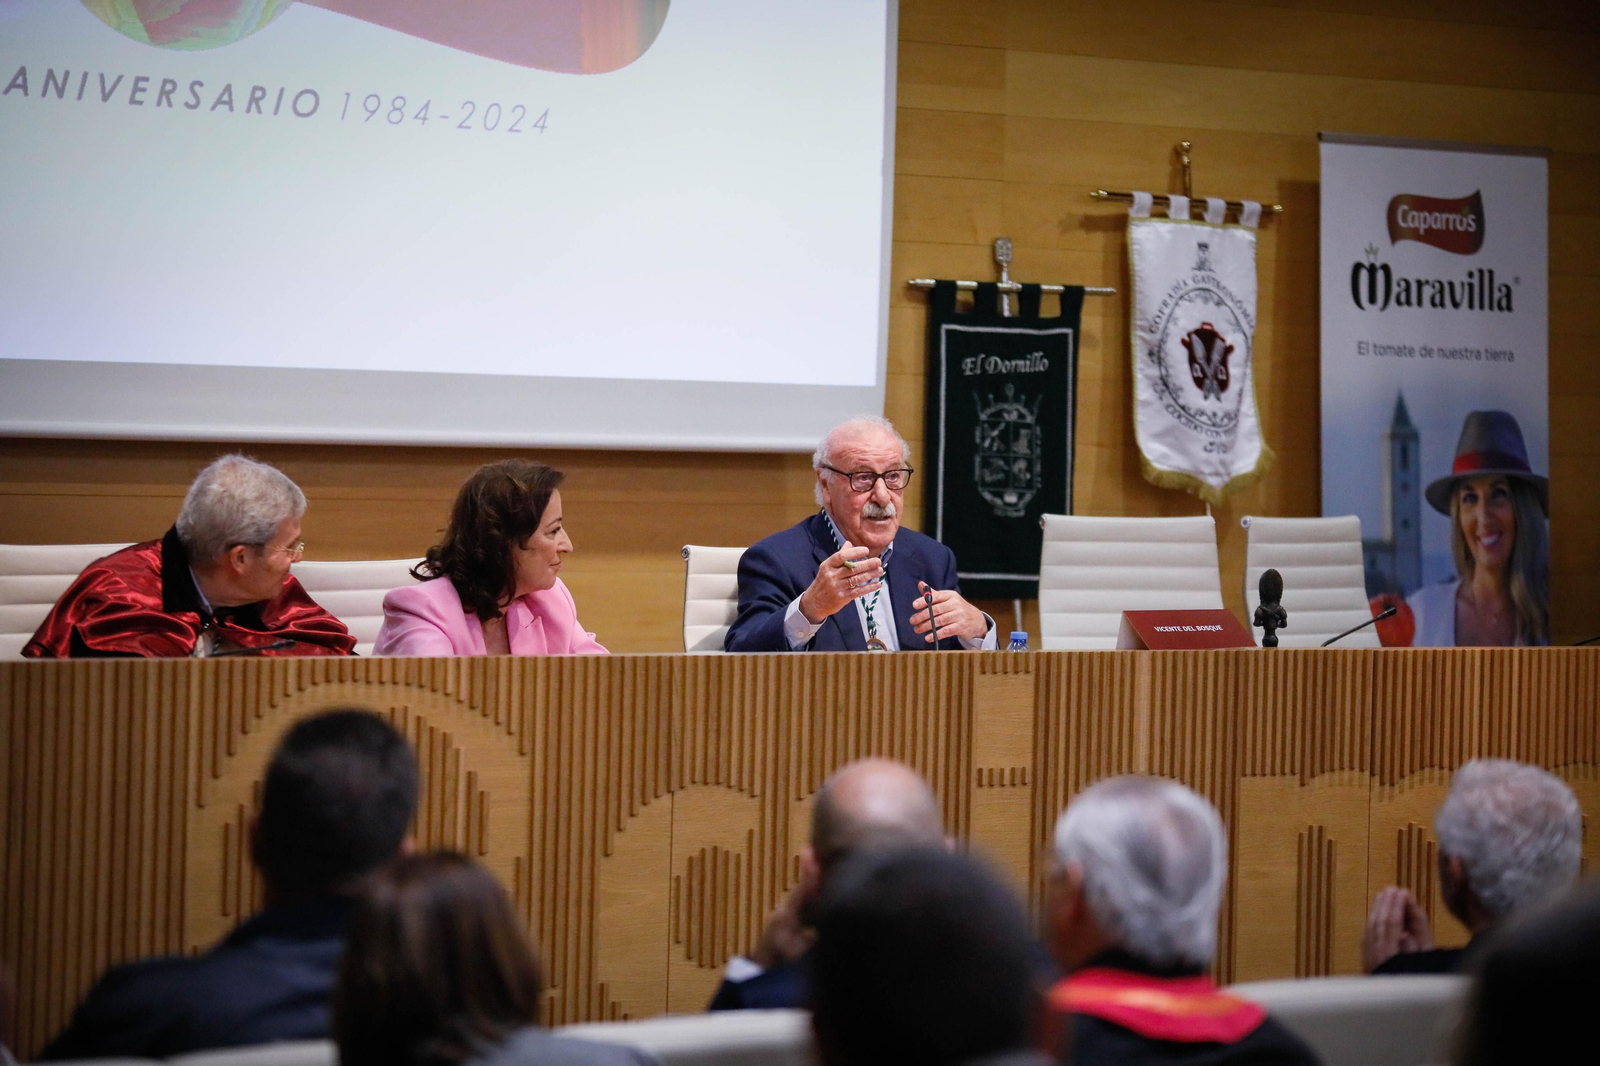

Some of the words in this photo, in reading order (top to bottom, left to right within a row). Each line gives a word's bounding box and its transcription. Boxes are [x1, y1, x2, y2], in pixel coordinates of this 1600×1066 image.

[2, 65, 321, 119] ANIVERSARIO
[339, 91, 550, 136] 1984-2024
[1351, 260, 1514, 313] Maravilla
[962, 353, 985, 376] El
[985, 350, 1049, 374] Dornillo
[1357, 340, 1370, 356] El
[1419, 344, 1435, 359] de
[1437, 347, 1482, 361] nuestra
[1485, 347, 1515, 363] tierra
[1195, 624, 1224, 632] BOSQUE
